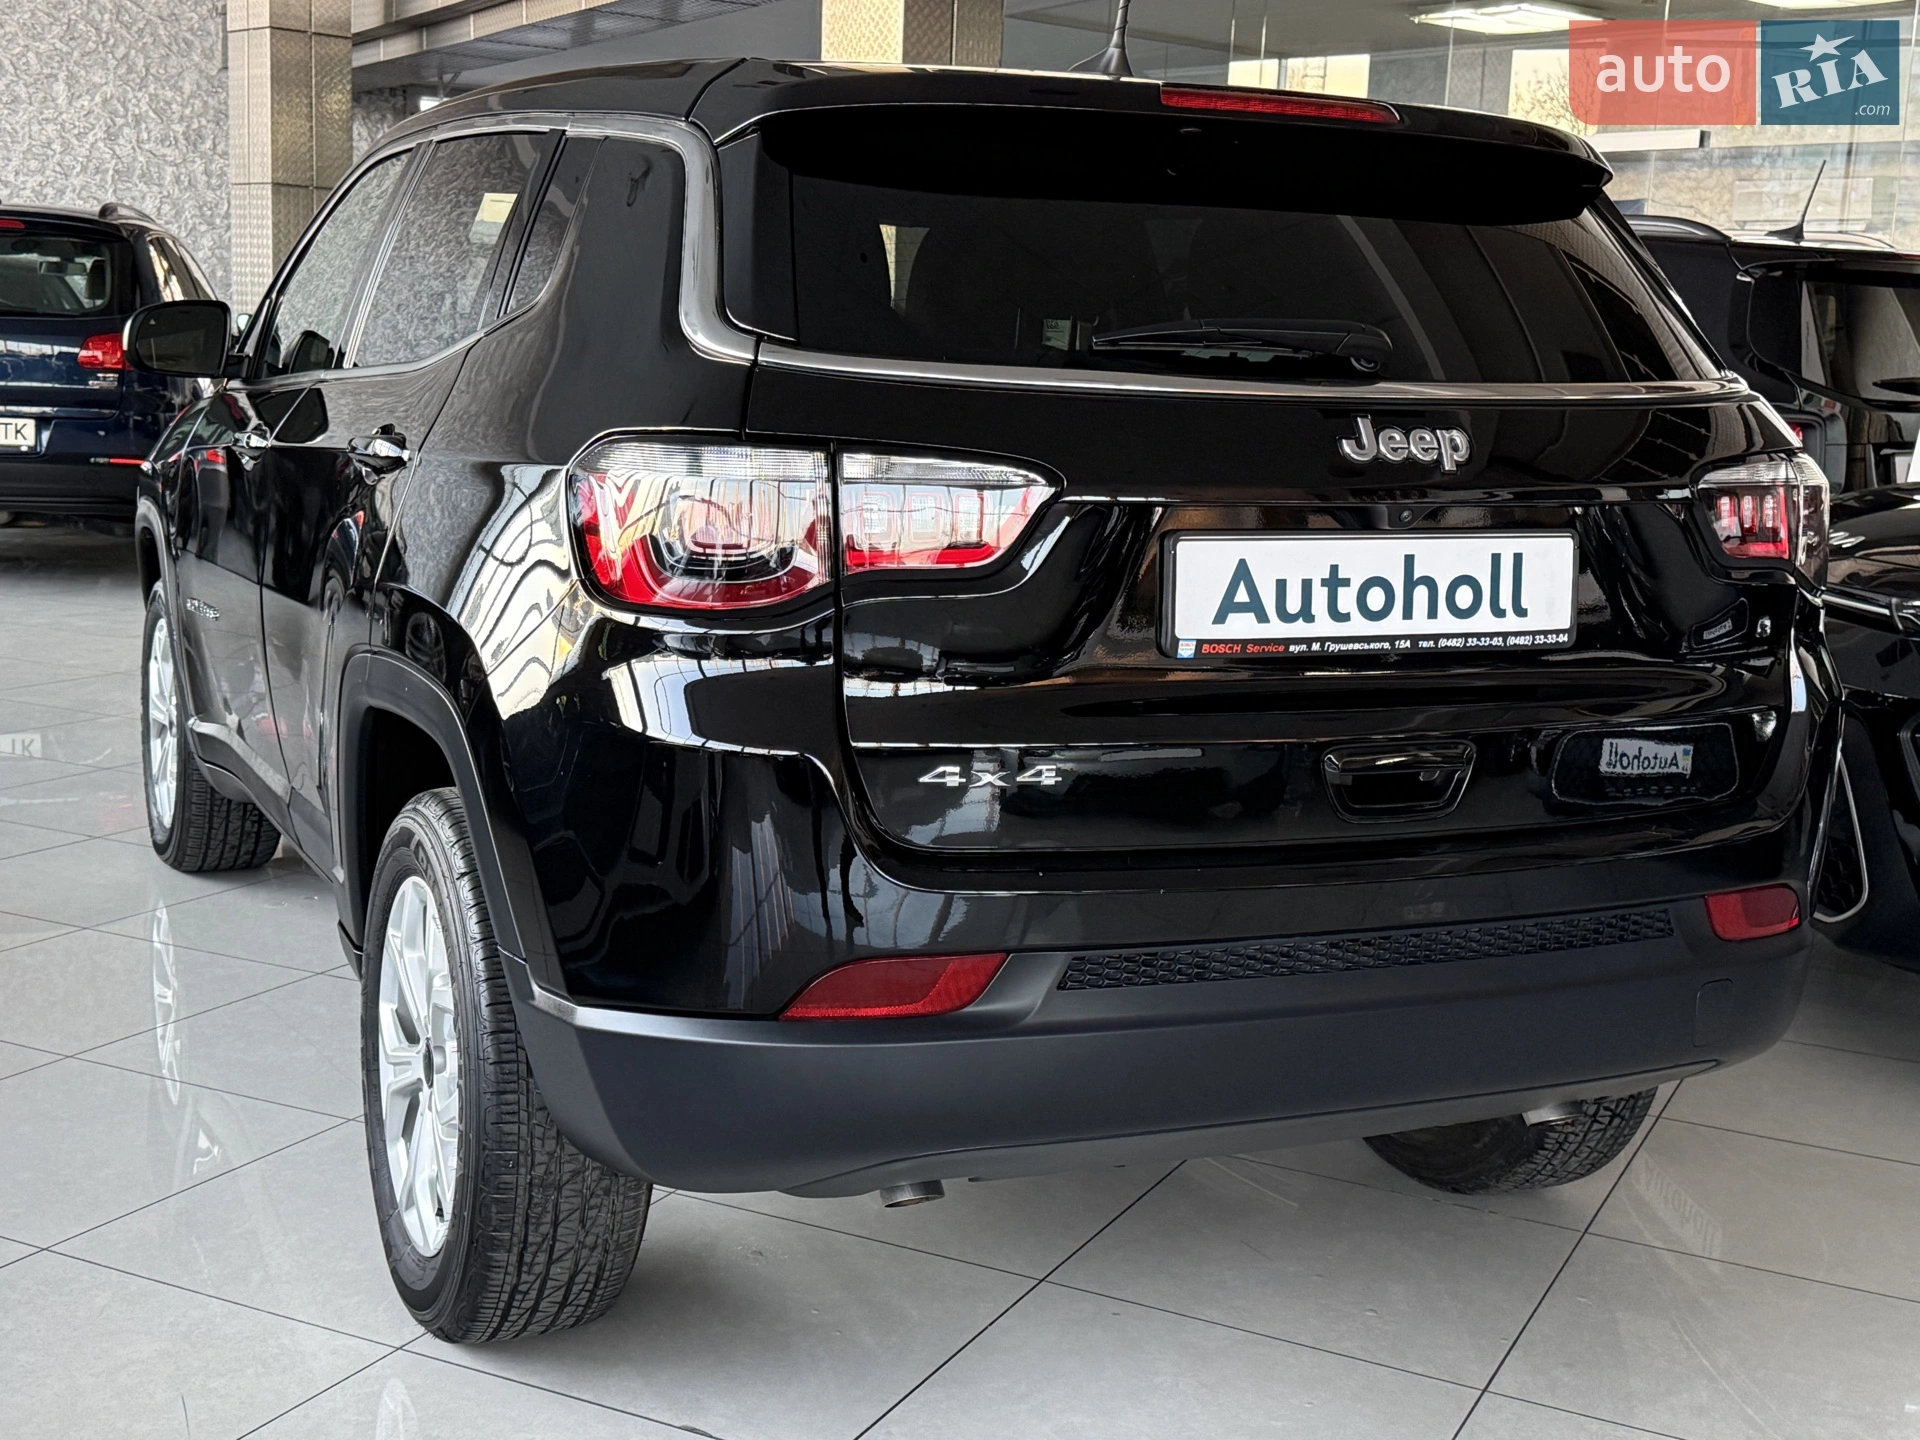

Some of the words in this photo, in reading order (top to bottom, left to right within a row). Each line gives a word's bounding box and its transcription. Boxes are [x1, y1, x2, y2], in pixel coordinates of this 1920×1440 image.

[1337, 414, 1471, 474] Jeep
[1211, 552, 1529, 625] Autoholl
[1201, 643, 1242, 654] BOSCH
[1246, 643, 1285, 653] Service
[1288, 643, 1309, 653] вул.
[1311, 641, 1322, 651] М.
[1324, 638, 1391, 653] Грушевського,
[1418, 639, 1436, 649] тел.
[1437, 637, 1465, 649] (0482)
[1466, 636, 1505, 648] 33-33-03,
[1506, 635, 1533, 647] (0482)
[1534, 633, 1569, 645] 33-33-04
[917, 765, 1063, 788] 4x4
